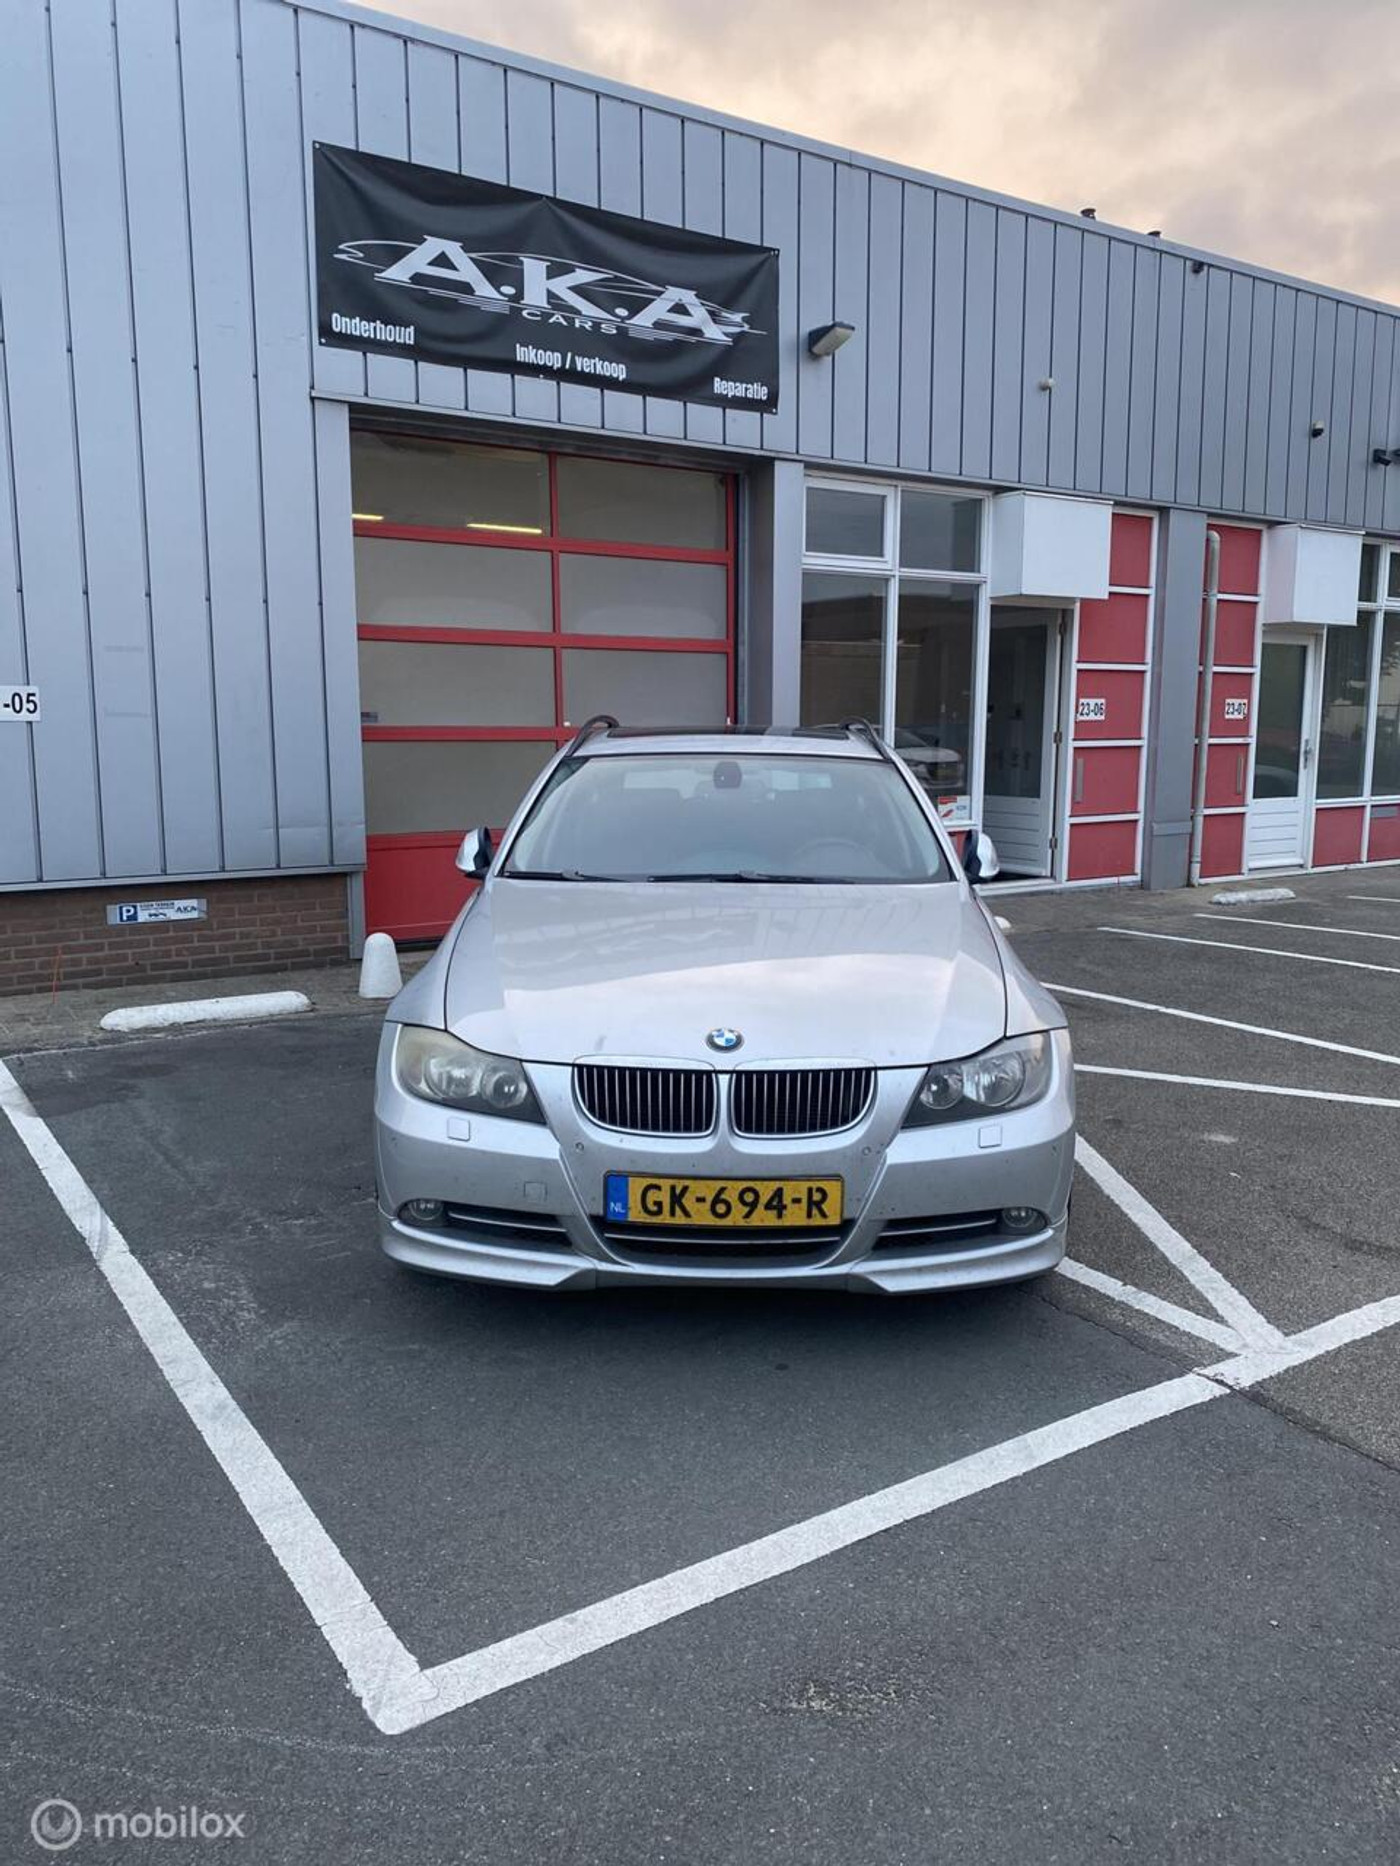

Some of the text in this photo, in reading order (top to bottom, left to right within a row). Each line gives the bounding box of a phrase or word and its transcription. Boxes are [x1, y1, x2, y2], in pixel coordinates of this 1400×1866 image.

[331, 313, 414, 345] Onderhoud
[521, 309, 618, 334] CARS
[516, 343, 561, 370] Inkoop
[575, 353, 627, 381] verkoop
[713, 377, 768, 400] Reparatie
[3, 692, 37, 714] -05
[610, 1202, 626, 1213] NL
[640, 1184, 829, 1219] GK-694-R
